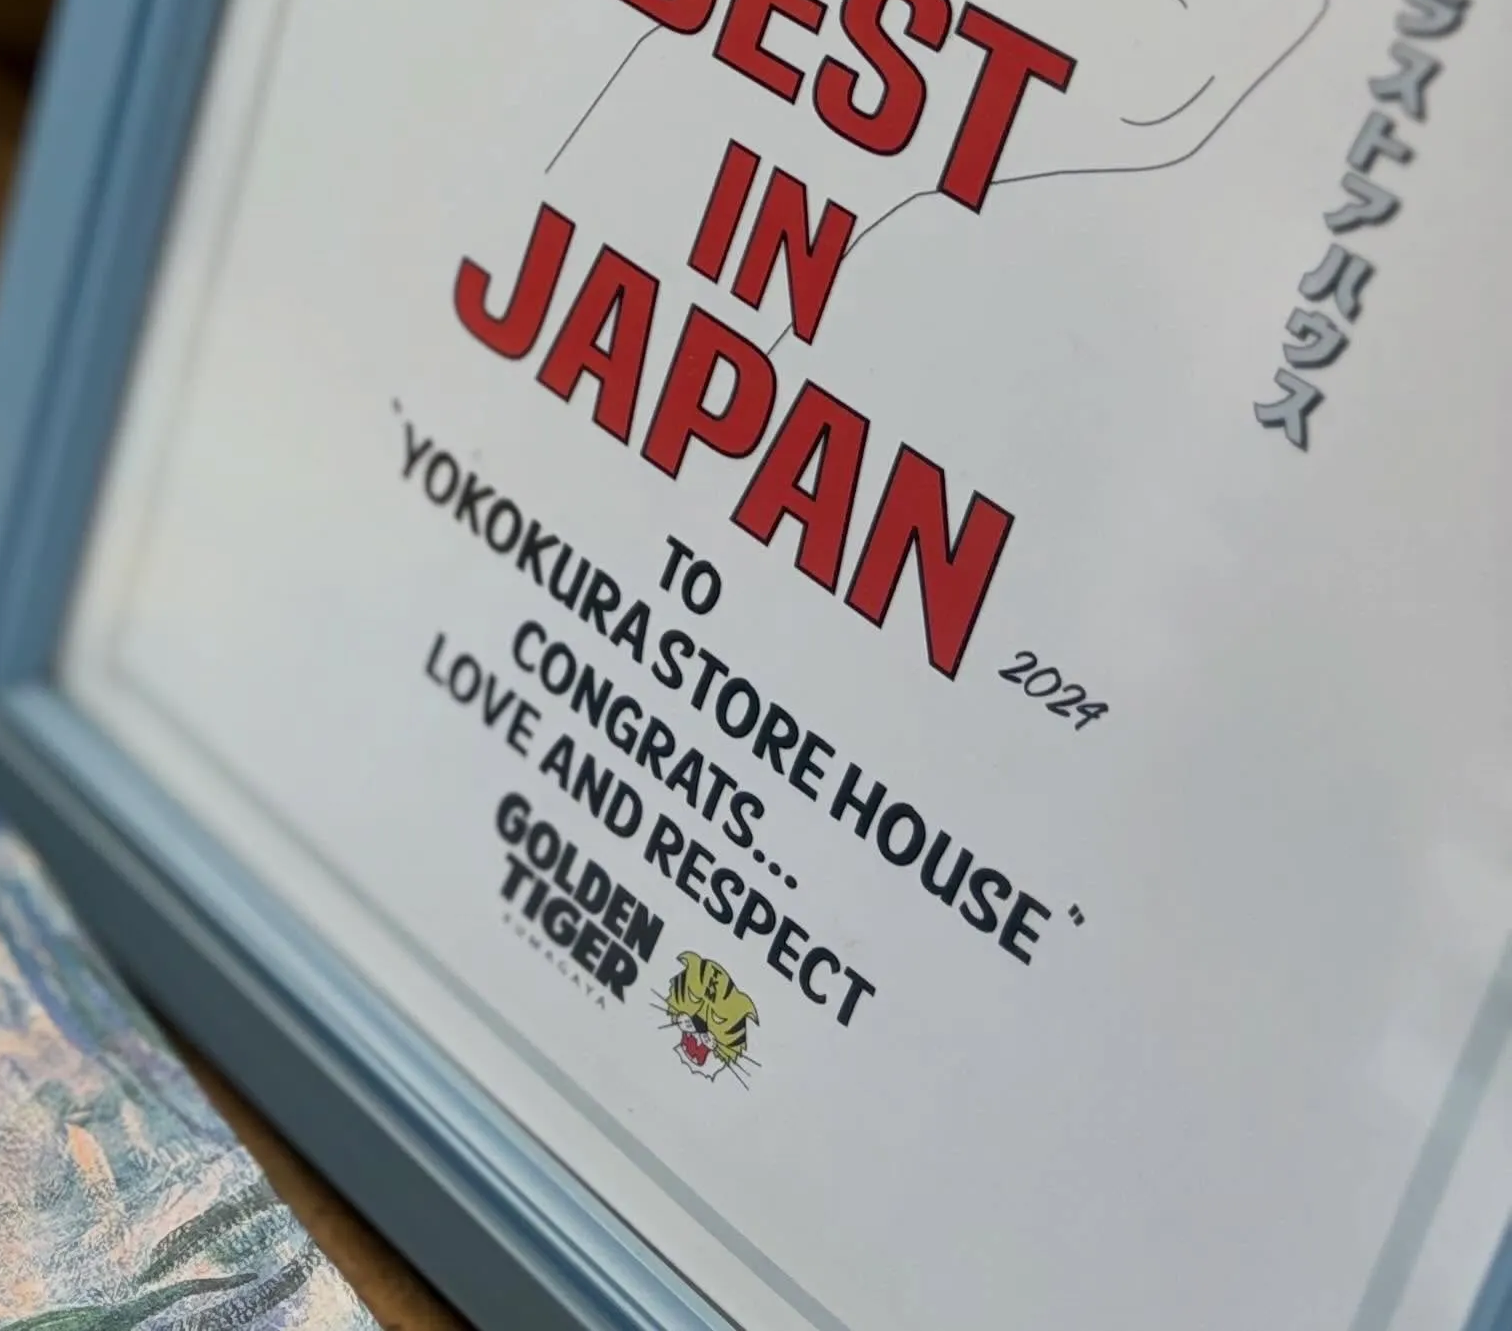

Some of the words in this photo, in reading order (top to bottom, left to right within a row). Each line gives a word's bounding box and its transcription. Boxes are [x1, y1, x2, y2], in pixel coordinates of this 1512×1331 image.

[687, 138, 857, 345] IN
[452, 201, 1015, 681] JAPAN
[658, 535, 723, 616] TO
[511, 619, 799, 890] CONGRATS...
[650, 628, 837, 802] STORE
[997, 650, 1110, 732] 2024
[423, 632, 542, 758] LOVE
[539, 740, 644, 842] AND
[643, 814, 877, 1028] RESPECT
[493, 790, 666, 964] GOLDEN
[496, 855, 639, 1005] TIGER
